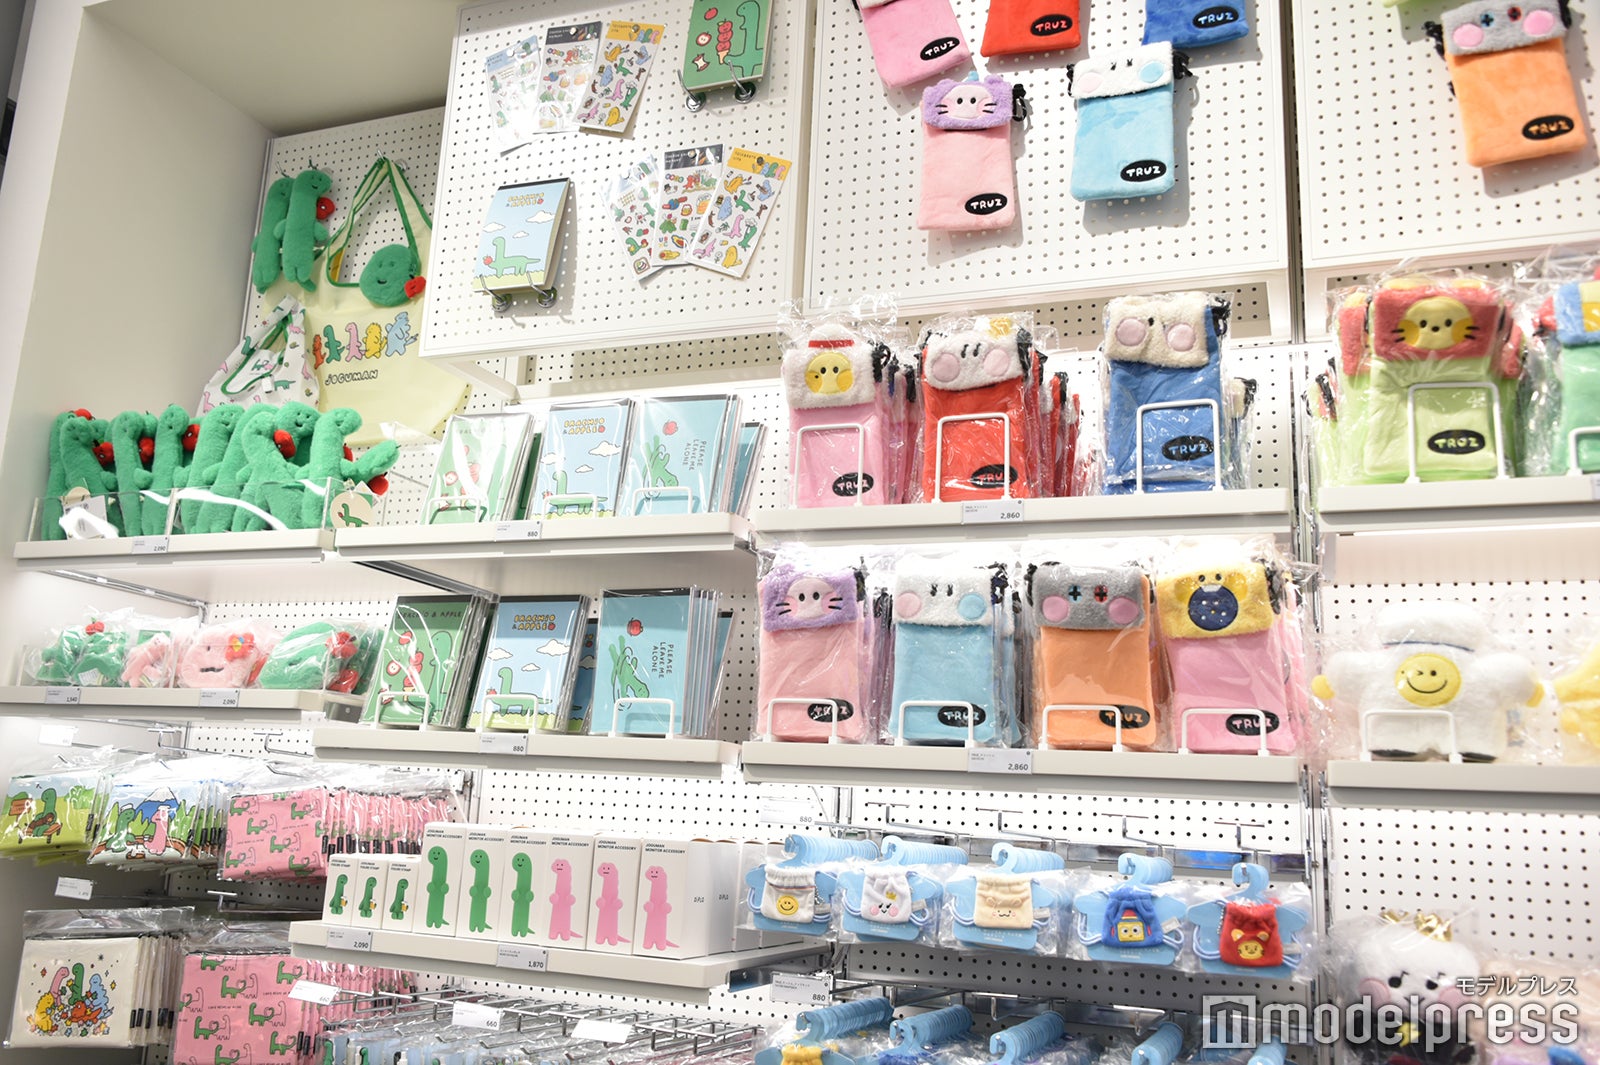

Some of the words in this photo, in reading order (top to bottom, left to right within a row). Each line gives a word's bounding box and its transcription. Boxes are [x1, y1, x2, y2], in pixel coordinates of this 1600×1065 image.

[1198, 12, 1233, 24] TRUZ
[1035, 20, 1068, 32] TRUZ
[925, 40, 956, 57] TRUZ
[1528, 120, 1570, 136] TRUZ
[1126, 165, 1161, 177] TRUZ
[970, 198, 1003, 210] TRUZ
[325, 369, 378, 386] JOGUMAN
[682, 442, 691, 466] ALONE
[691, 438, 699, 460] LEAVE
[697, 440, 707, 467] PLEASE
[1168, 443, 1208, 456] TRUZ
[689, 460, 696, 471] ME
[1000, 511, 1021, 520] 2,860
[440, 610, 463, 618] APPLE
[514, 614, 556, 623] BRACHIO
[518, 622, 548, 631] APPLE
[666, 644, 674, 674] PLEASE
[659, 667, 665, 679] ME
[813, 705, 848, 717] TRZ
[1105, 711, 1144, 723] TUZ
[1007, 763, 1029, 771] 2,860
[353, 941, 369, 949] 2,090
[528, 960, 544, 969] 1,870
[812, 993, 826, 1002] 880
[486, 1020, 498, 1028] 660
